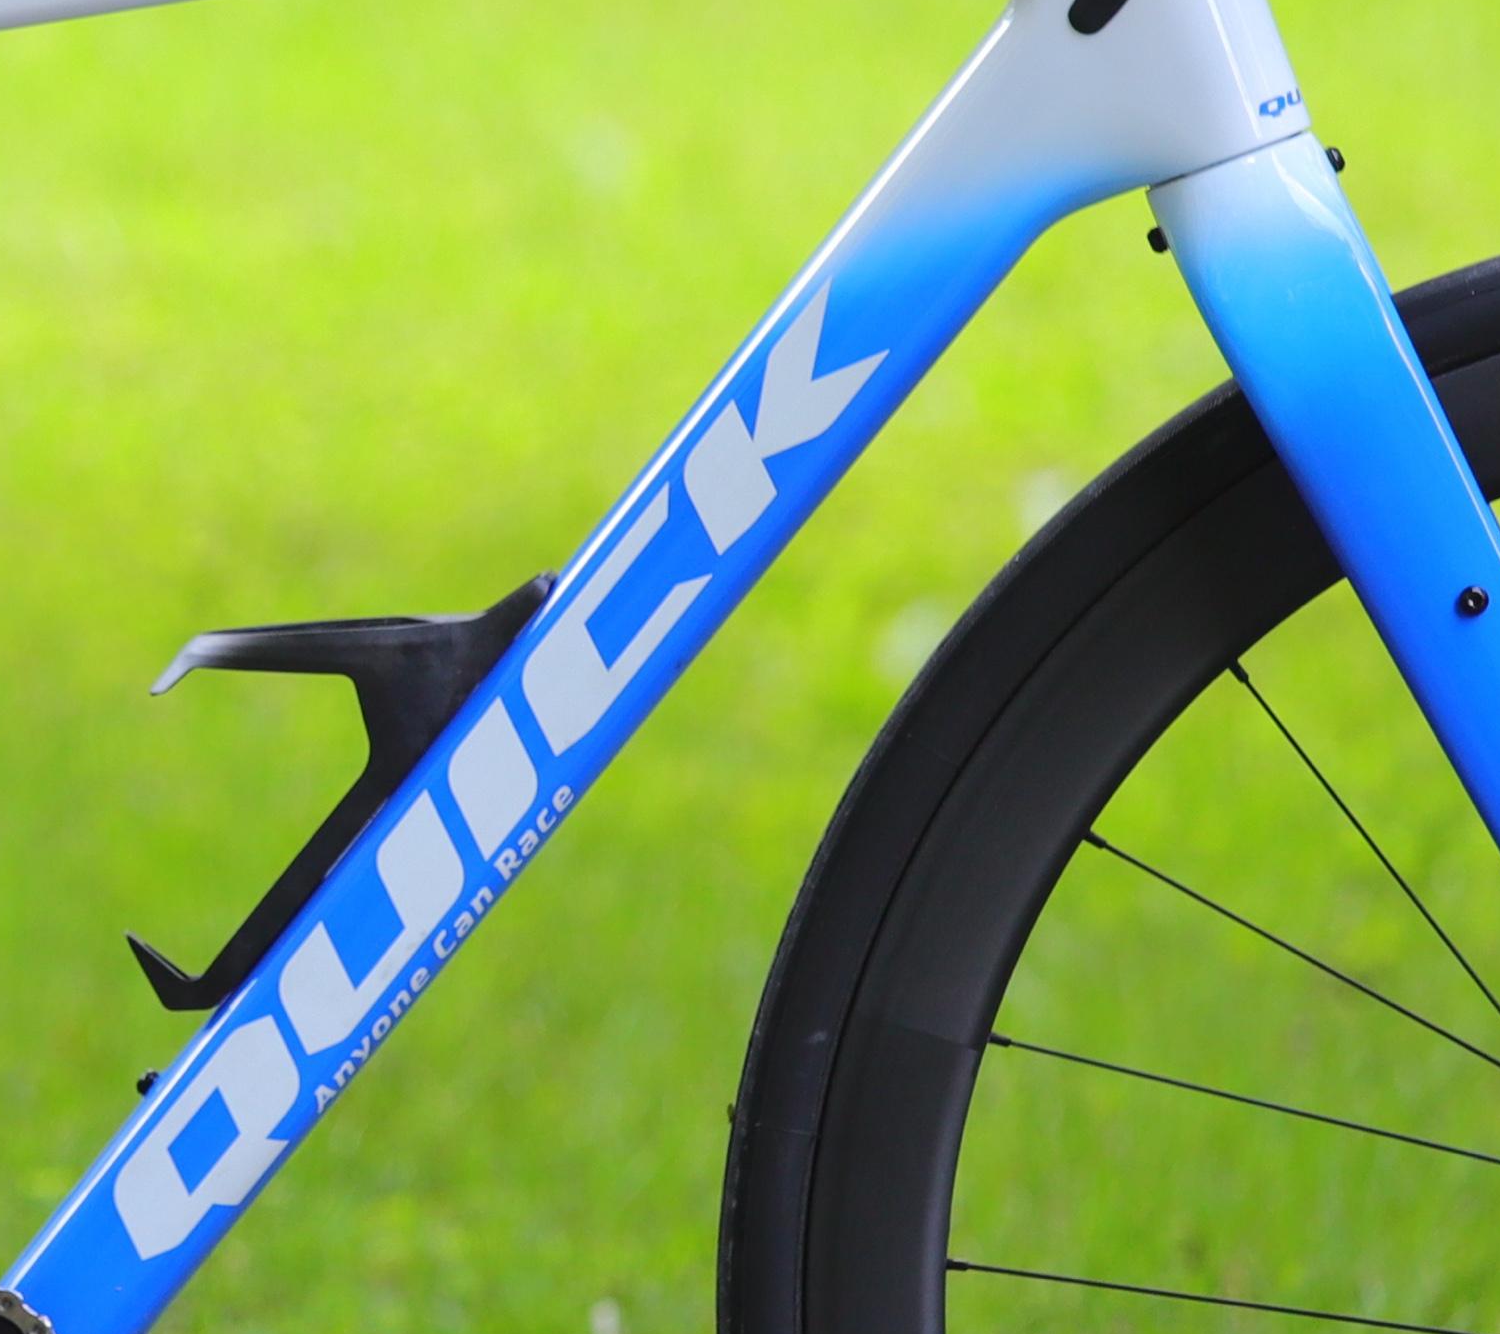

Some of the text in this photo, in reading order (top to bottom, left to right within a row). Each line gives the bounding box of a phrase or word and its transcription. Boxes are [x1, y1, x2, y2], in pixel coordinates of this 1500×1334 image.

[113, 278, 890, 1260] QUICK
[314, 783, 575, 1113] Anyone Can Race
